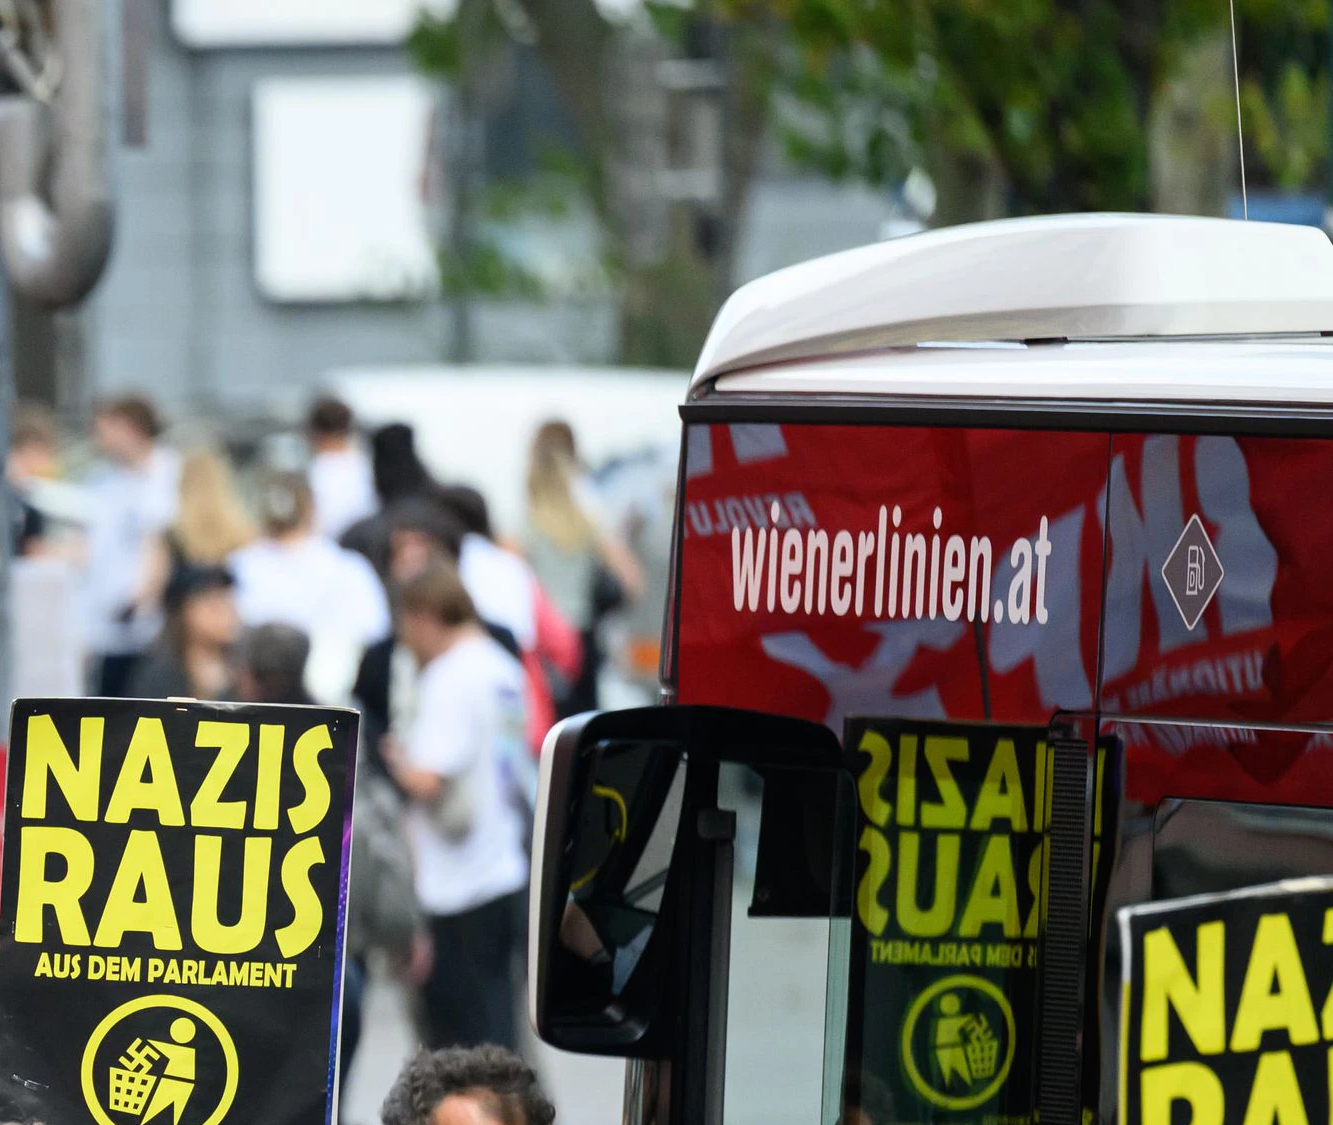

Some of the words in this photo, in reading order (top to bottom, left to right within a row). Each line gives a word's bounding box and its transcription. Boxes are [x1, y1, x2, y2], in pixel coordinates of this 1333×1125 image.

[732, 500, 1053, 626] wienerlinien.at
[21, 713, 334, 835] NAZIS
[14, 826, 326, 959] RAUS
[34, 952, 83, 981] AUS
[88, 955, 140, 983] DEM
[146, 957, 297, 989] PARLAMENT
[1139, 907, 1333, 1062] NA
